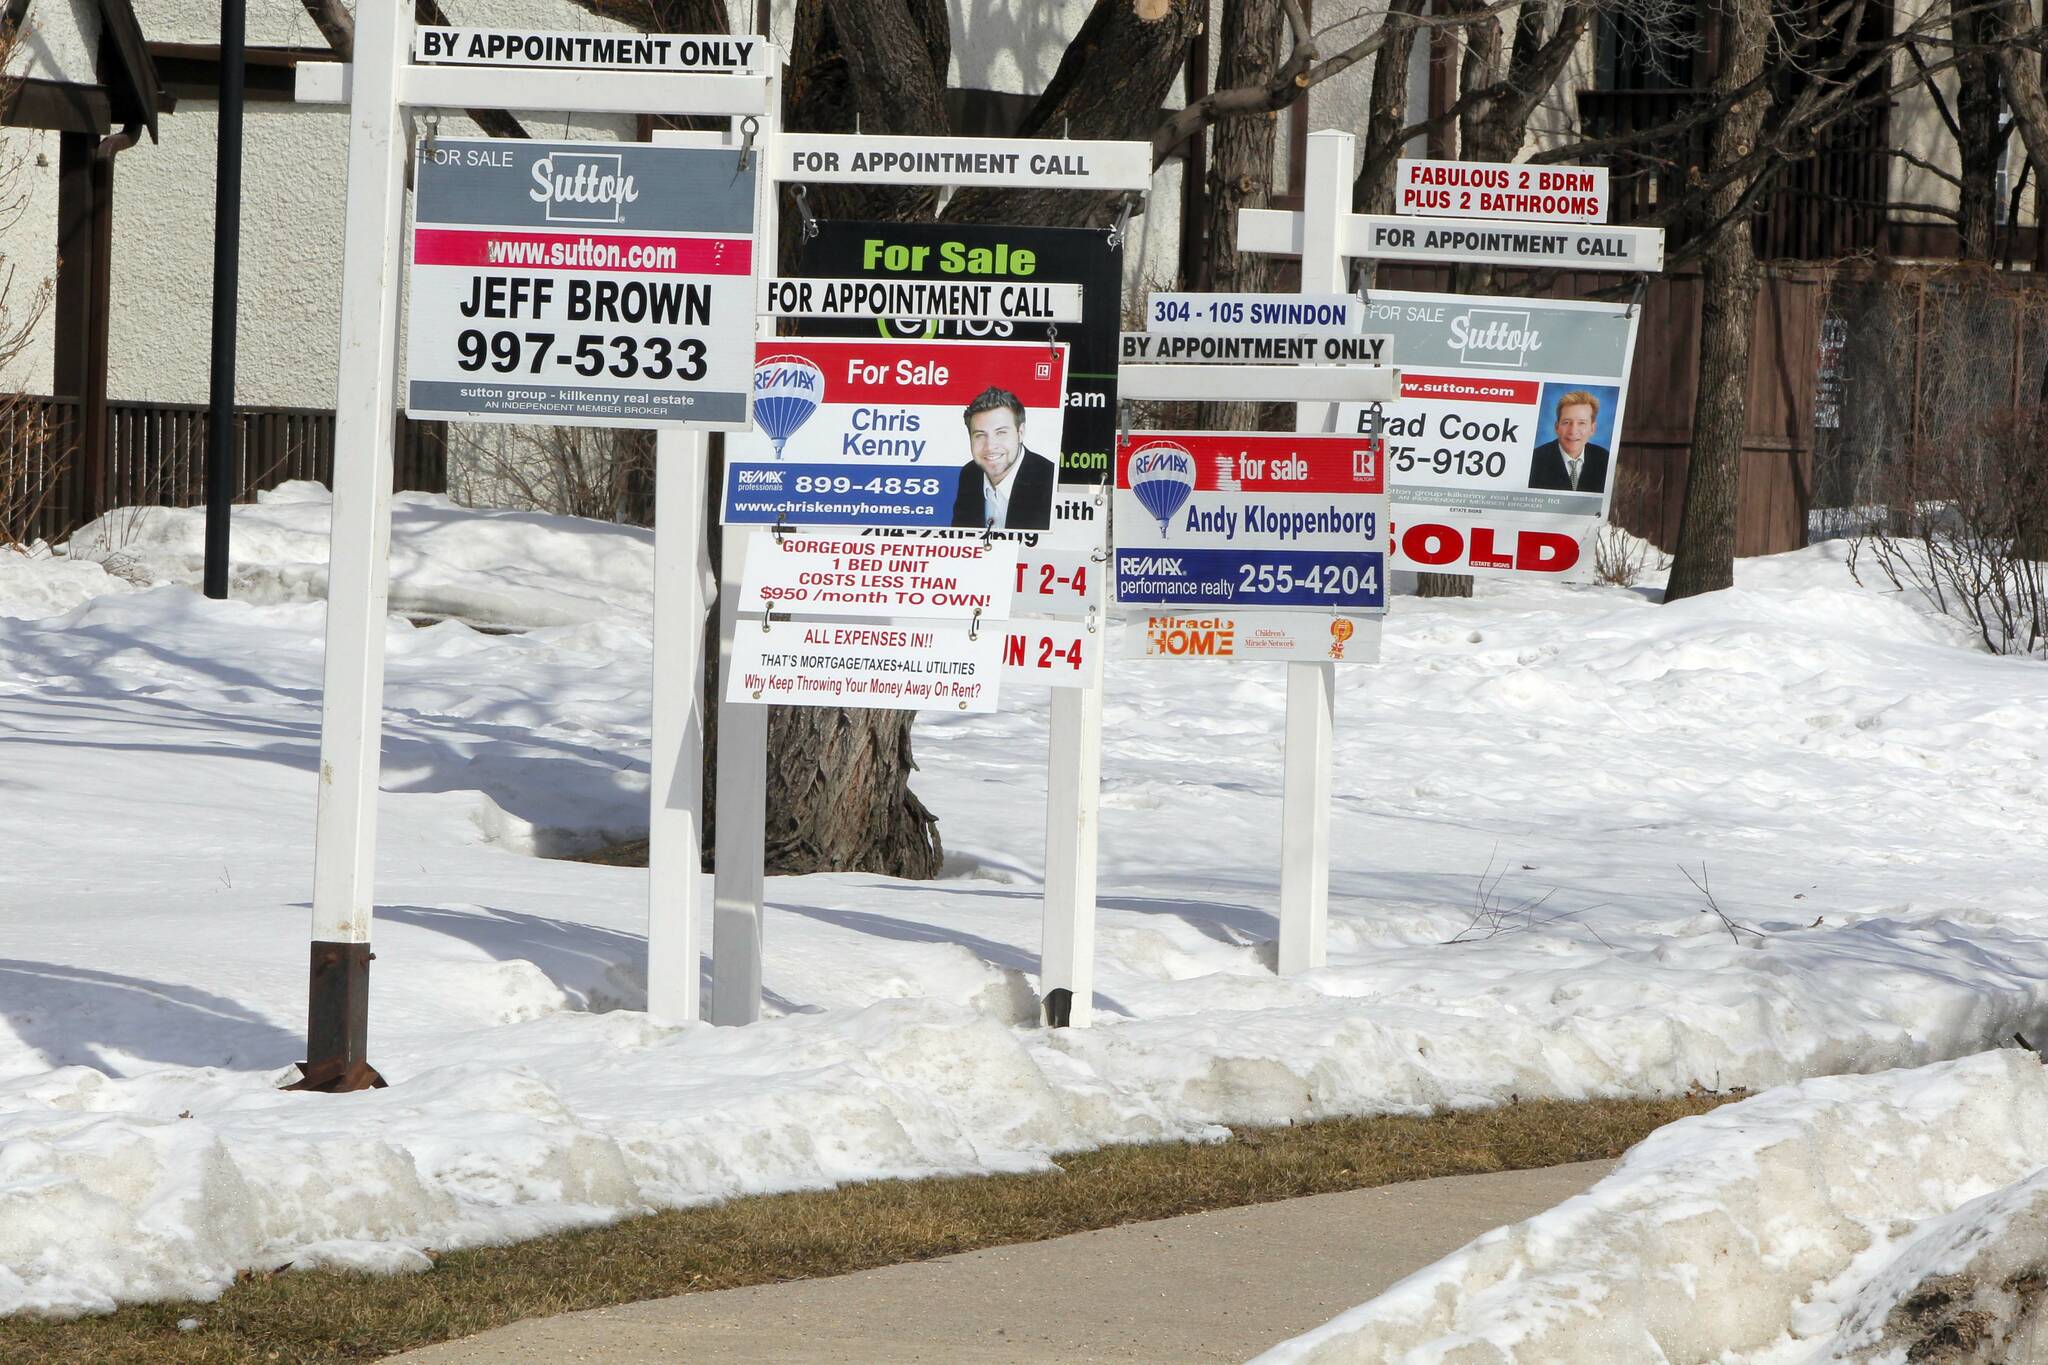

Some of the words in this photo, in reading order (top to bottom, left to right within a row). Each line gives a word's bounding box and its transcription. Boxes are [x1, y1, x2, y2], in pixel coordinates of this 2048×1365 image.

[423, 32, 460, 58] BY
[467, 34, 671, 65] APPOINTMENT
[680, 41, 754, 66] ONLY
[467, 151, 514, 167] SALE
[793, 152, 839, 172] FOR
[851, 152, 1019, 174] APPOINTMENT
[1030, 155, 1089, 175] CALL
[530, 158, 639, 205] Sutton
[1411, 166, 1509, 189] FABULOUS
[1519, 172, 1530, 190] 2
[1539, 173, 1594, 193] BDRM
[1404, 189, 1450, 208] PLUS
[1460, 191, 1471, 210] 2
[1480, 192, 1599, 216] BATHROOMS
[488, 239, 676, 269] www.sutton.com
[1375, 228, 1415, 247] FOR
[1424, 230, 1568, 254] APPOINTMENT
[1576, 237, 1628, 257] CALL
[863, 239, 931, 271] For
[939, 241, 1036, 276] Sale
[460, 276, 553, 320] JEFF
[567, 279, 712, 326] BROWN
[767, 281, 813, 313] FOR
[821, 283, 991, 318] APPOINTMENT
[999, 286, 1054, 318] CALL
[1155, 301, 1190, 322] 304
[1209, 302, 1244, 323] 105
[1250, 303, 1347, 325] SWINDON
[1370, 304, 1401, 320] FOR
[1407, 307, 1445, 322] SALE
[1447, 315, 1542, 352] Sutton
[457, 329, 708, 382] 997-5333
[1123, 337, 1151, 357] BY
[1157, 337, 1317, 360] APPOINTMENT
[1324, 339, 1385, 360] ONLY
[847, 359, 889, 385] For
[895, 360, 949, 387] Sale
[460, 387, 503, 398] sutton
[507, 388, 547, 402] group
[559, 390, 619, 405] killkenny
[624, 392, 649, 404] real
[653, 394, 694, 406] estate
[1400, 383, 1515, 397] w.sutton.com
[485, 401, 499, 409] AN
[501, 401, 574, 412] INDEPENDENT
[576, 404, 622, 413] MEMBER
[624, 405, 667, 415] BROKER
[851, 408, 920, 432] Chris
[1440, 414, 1519, 443] Cook
[842, 433, 926, 462] Kenny
[1136, 453, 1188, 475] RE/MAX
[1239, 452, 1266, 479] for
[1271, 452, 1308, 480] sale
[1390, 447, 1506, 478] 75-9130
[738, 483, 783, 492] professionals
[739, 470, 783, 484] RE/MAX
[795, 476, 940, 496] 899-4858
[735, 501, 934, 516] www.chriskennyhomes.ca
[1186, 505, 1238, 540] Andy
[1245, 505, 1376, 540] Kloppenborg
[783, 540, 875, 556] GORGEOUS
[880, 542, 983, 559] PENTHOUSE
[832, 558, 840, 570] 1
[848, 559, 882, 572] BED
[888, 560, 929, 573] UNIT
[1120, 557, 1183, 576] RE/MAX
[799, 573, 853, 586] COSTS
[861, 575, 904, 588] LESS
[910, 576, 957, 590] THAN
[1039, 564, 1086, 596] 2-4
[1121, 579, 1197, 598] performance
[1201, 579, 1235, 599] realty
[1239, 564, 1378, 595] 255-4204
[760, 586, 807, 601] $950
[813, 588, 888, 604] /month
[898, 591, 925, 605] TO
[931, 593, 990, 607] OWN!
[804, 629, 831, 644] ALL
[834, 630, 907, 647] EXPENSES
[911, 633, 933, 648] IN!!
[1147, 630, 1234, 655] HOME
[761, 654, 797, 668] THAT'S
[800, 655, 923, 673] MORTGAGE/TAXES+ALL
[926, 660, 975, 675] UTILITIES
[1037, 636, 1082, 670] 2-4
[744, 674, 767, 691] Why
[768, 675, 794, 693] Keep
[797, 675, 843, 695] Throwing
[845, 678, 868, 694] Your
[870, 679, 901, 697] Money
[904, 681, 931, 697] Away
[934, 682, 949, 696] On
[951, 683, 981, 699] Rent?
